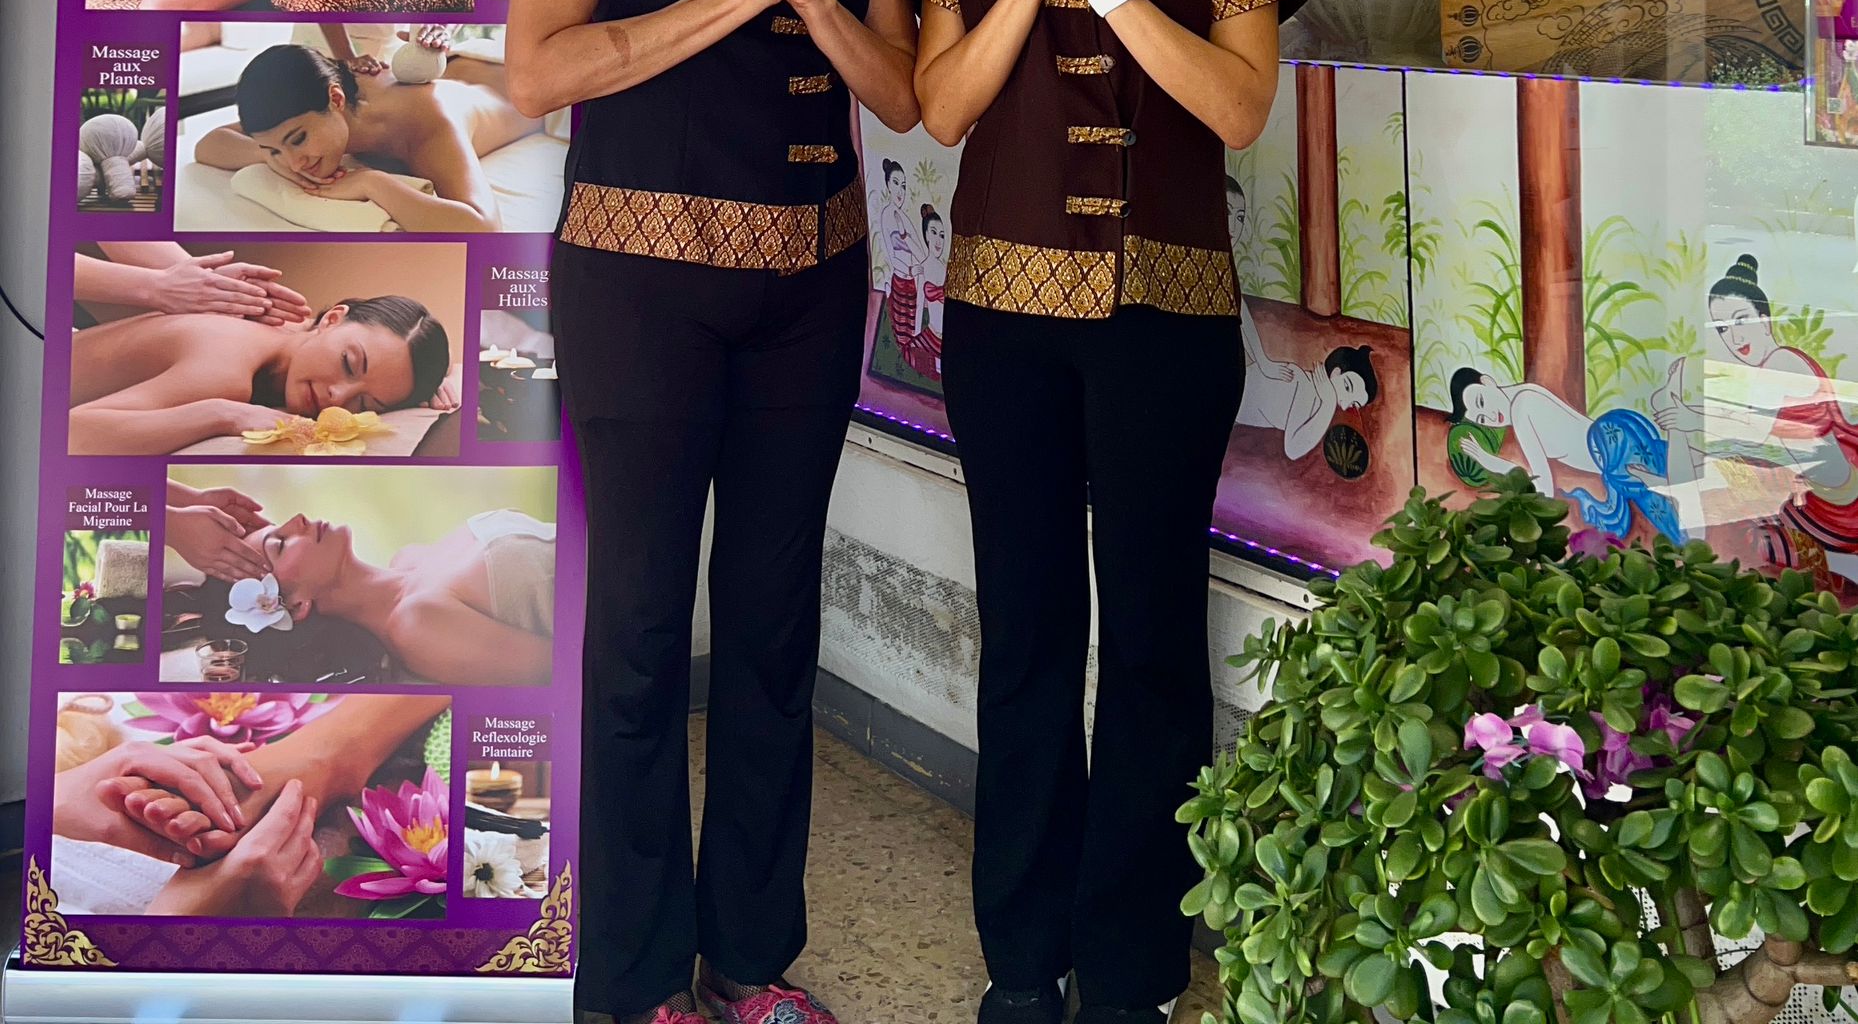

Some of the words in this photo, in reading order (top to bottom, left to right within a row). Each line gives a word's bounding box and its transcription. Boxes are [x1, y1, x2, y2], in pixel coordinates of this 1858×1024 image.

[92, 45, 160, 62] Massage
[113, 62, 141, 72] aux
[99, 72, 155, 85] Plantes
[491, 266, 549, 283] Massag
[509, 283, 537, 293] aux
[498, 293, 548, 307] Huiles
[85, 488, 132, 502] Massage
[69, 501, 101, 513] Facial
[105, 501, 131, 513] Pour
[133, 501, 148, 513] La
[83, 515, 132, 529] Migraine
[485, 717, 536, 732] Massage
[472, 731, 547, 746] Reflexologie
[482, 745, 534, 758] Plantaire
